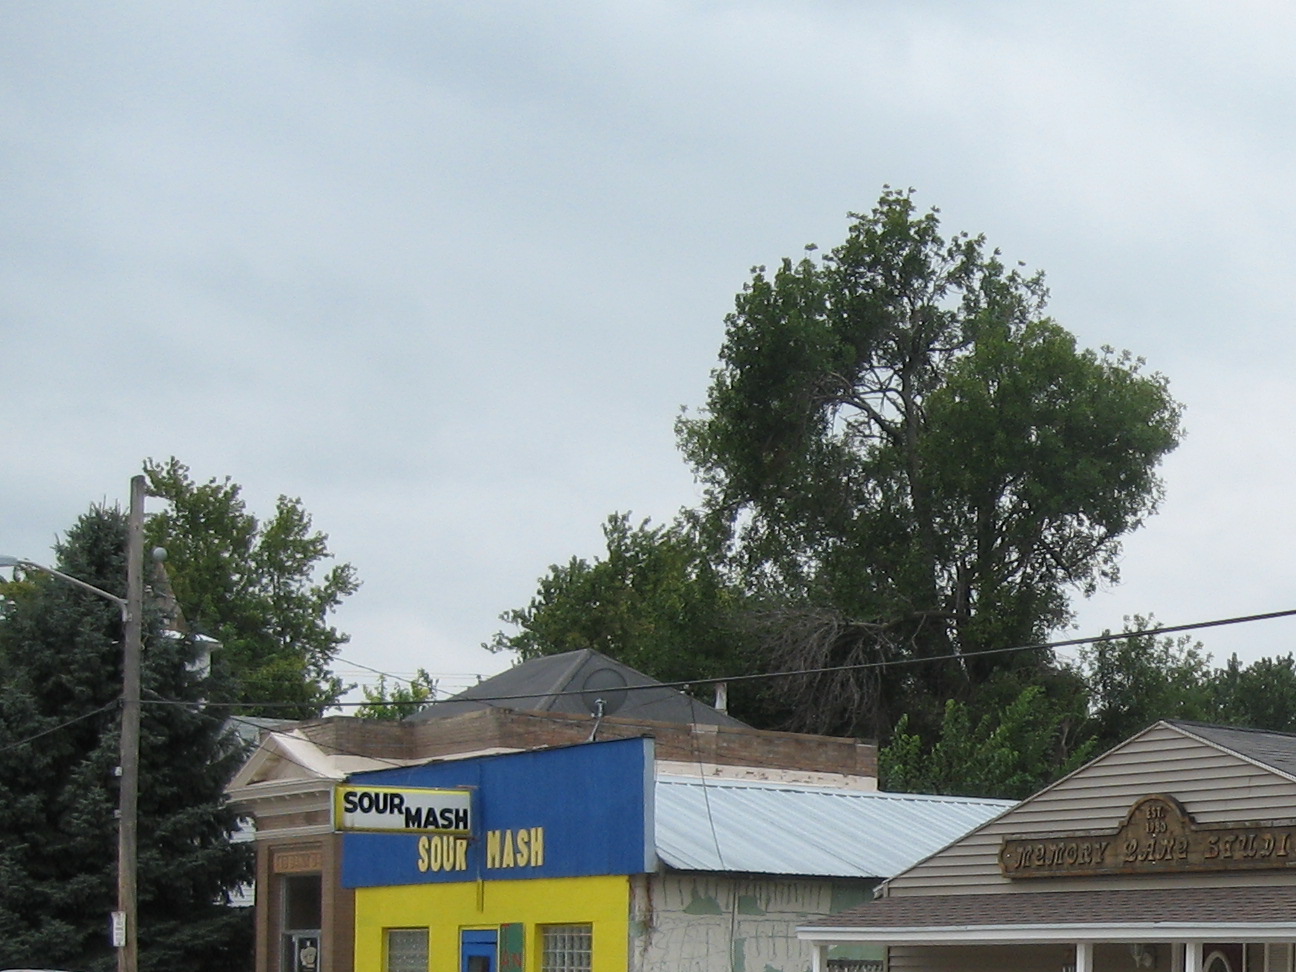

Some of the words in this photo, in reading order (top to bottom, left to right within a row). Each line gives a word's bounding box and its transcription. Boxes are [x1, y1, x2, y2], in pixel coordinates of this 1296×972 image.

[343, 791, 404, 814] SOUR
[405, 807, 469, 830] MASH
[1145, 806, 1164, 819] EST.
[418, 835, 467, 872] SOUR
[487, 827, 544, 869] MASH
[1014, 842, 1111, 869] MEMORY
[1123, 837, 1190, 863] LANE
